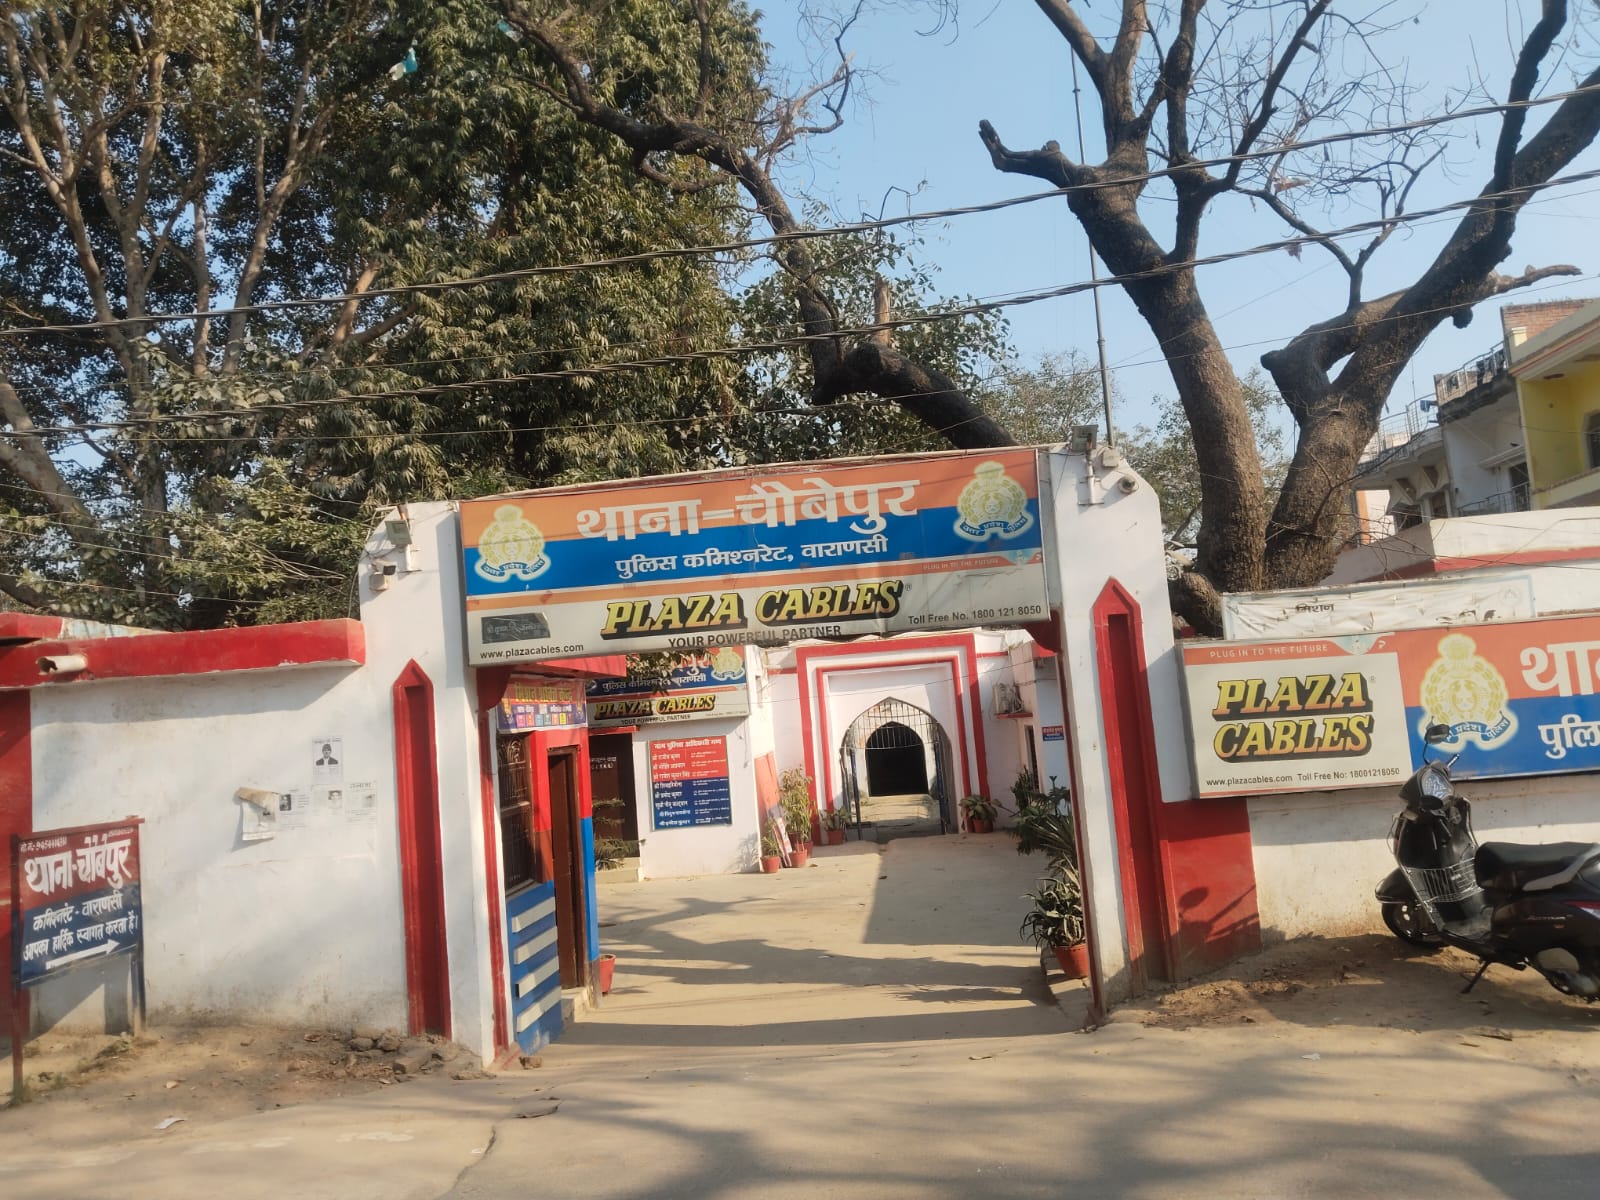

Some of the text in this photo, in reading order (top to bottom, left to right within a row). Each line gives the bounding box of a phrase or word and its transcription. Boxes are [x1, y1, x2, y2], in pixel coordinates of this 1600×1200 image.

[615, 533, 889, 579] पुलिस कमिश्नरेट, वाराणसी
[600, 579, 904, 640] PLAZA CABLES
[907, 604, 1042, 626] Toll Free No. 1800 121 8050
[668, 619, 842, 649] YOUR POWERFUL PARTNER
[480, 642, 585, 660] www.plazacables.com
[1209, 644, 1328, 659] PLUG IN TO THE FUTURE
[1520, 641, 1600, 697] था
[594, 699, 654, 720] PLAZA
[656, 694, 717, 715] CABLES
[1212, 672, 1373, 721] PLAZA
[667, 713, 692, 722] PARTNER
[1213, 714, 1375, 763] CABLES
[1538, 713, 1600, 760] पुलि
[1206, 767, 1401, 787] www.plazacables.com Toll Free No: 18001218050
[82, 889, 124, 918] वाराणसी
[23, 938, 49, 961] आपका
[52, 927, 74, 955] हार्दिक
[76, 922, 104, 944] स्वागत
[105, 917, 128, 935] करता
